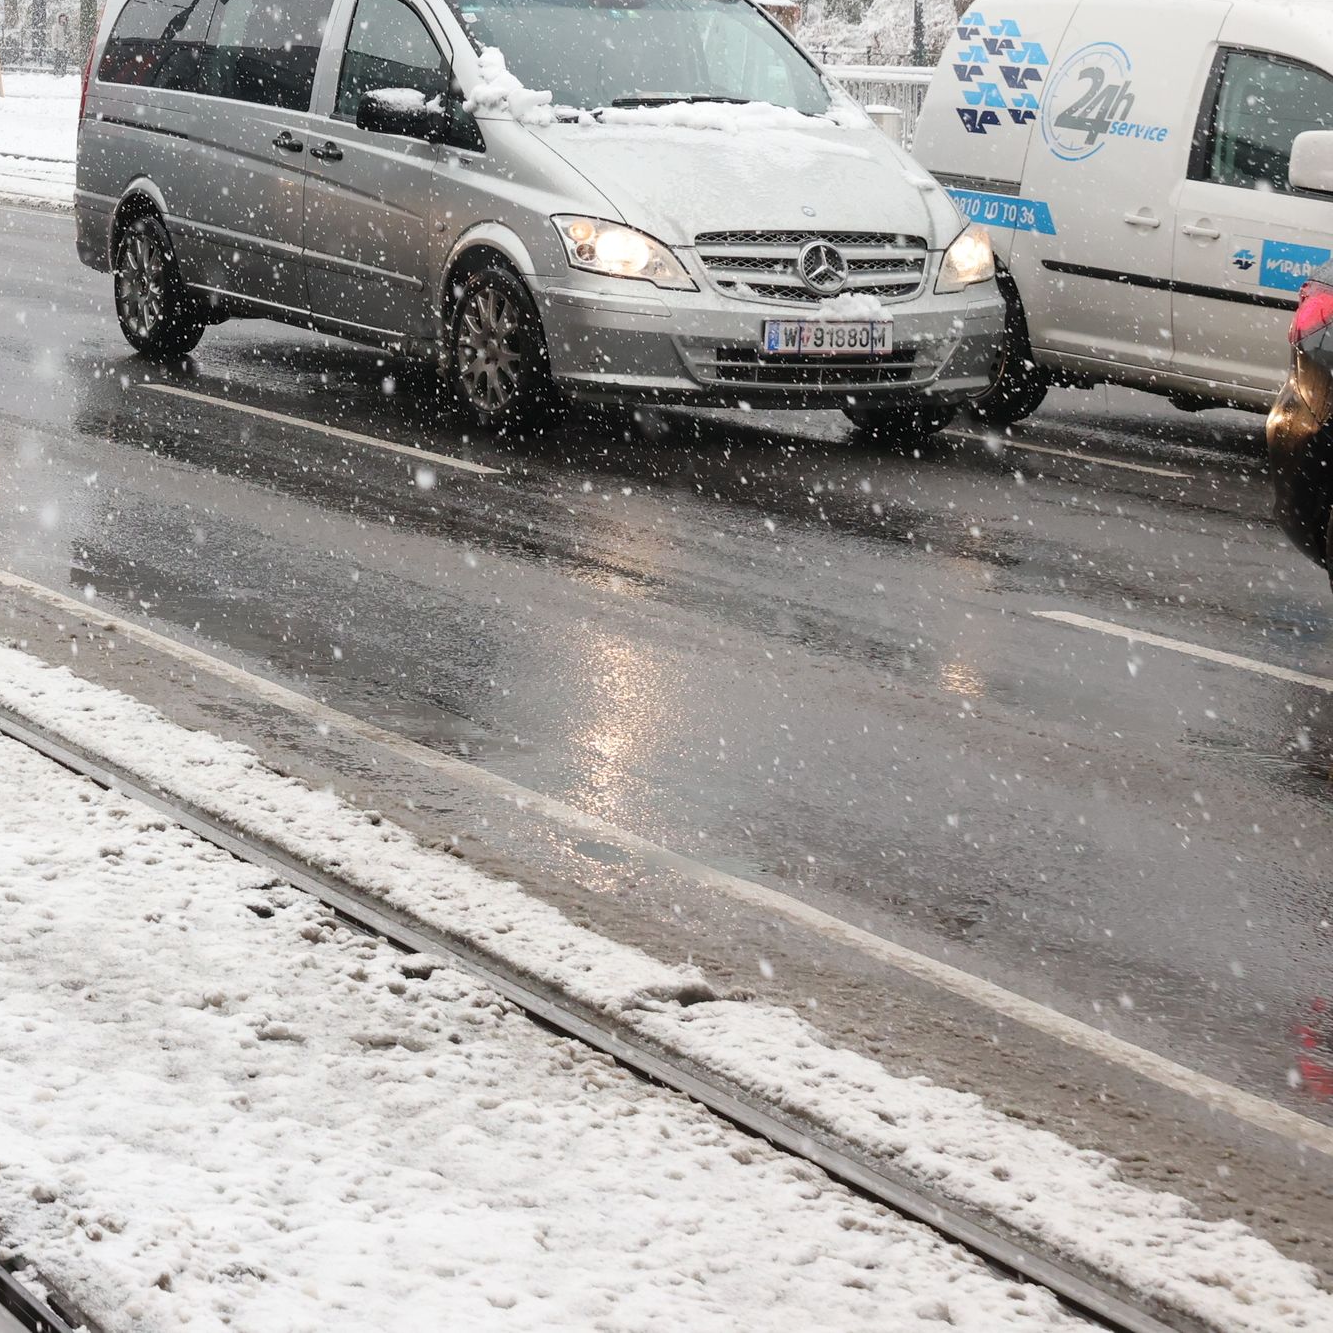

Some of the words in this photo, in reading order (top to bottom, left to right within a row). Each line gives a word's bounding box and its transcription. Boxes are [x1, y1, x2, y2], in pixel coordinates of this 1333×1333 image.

[1054, 66, 1135, 145] 24h
[1109, 121, 1168, 142] service
[984, 201, 999, 219] 10
[1019, 206, 1035, 224] 36
